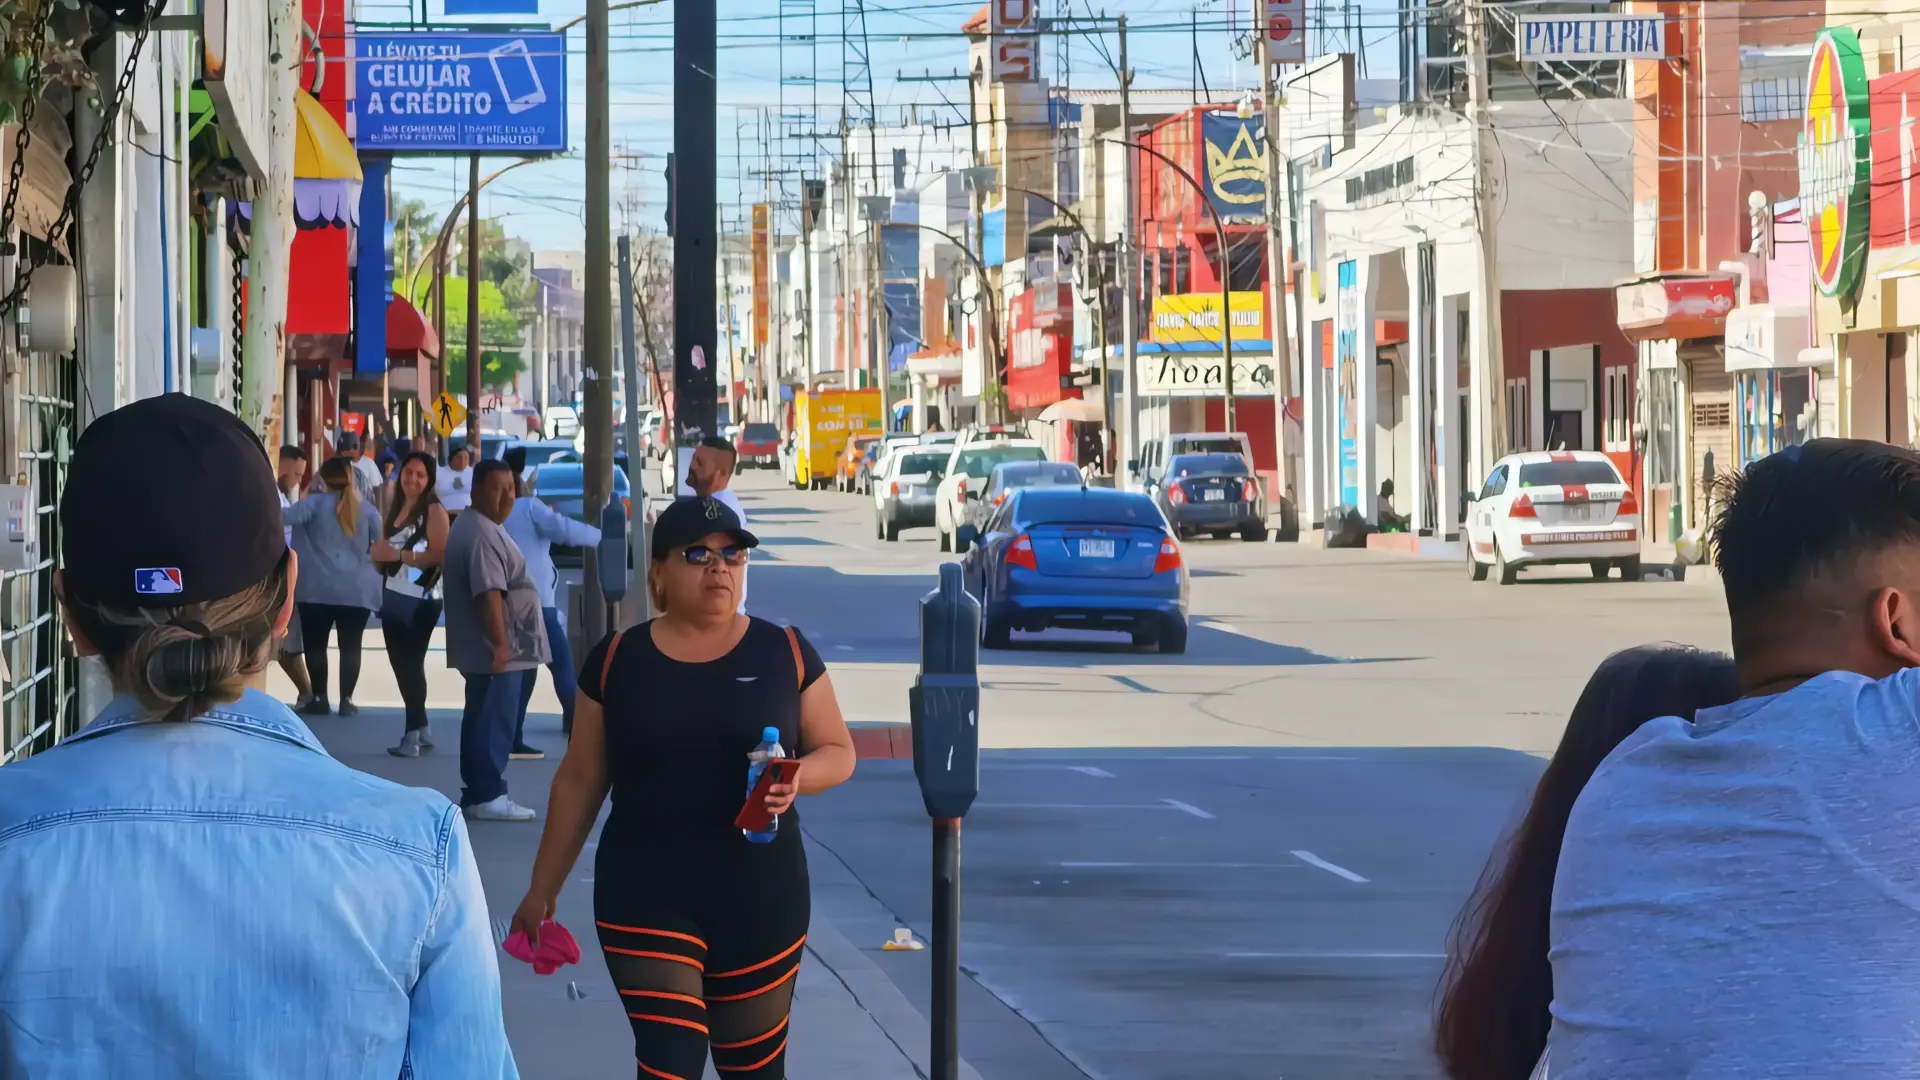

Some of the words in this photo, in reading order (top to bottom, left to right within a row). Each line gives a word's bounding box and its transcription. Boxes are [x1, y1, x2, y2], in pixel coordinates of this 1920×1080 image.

[439, 44, 461, 61] TU
[368, 64, 471, 87] CELULAR
[367, 92, 385, 114] A
[390, 86, 492, 115] CRÉDITO
